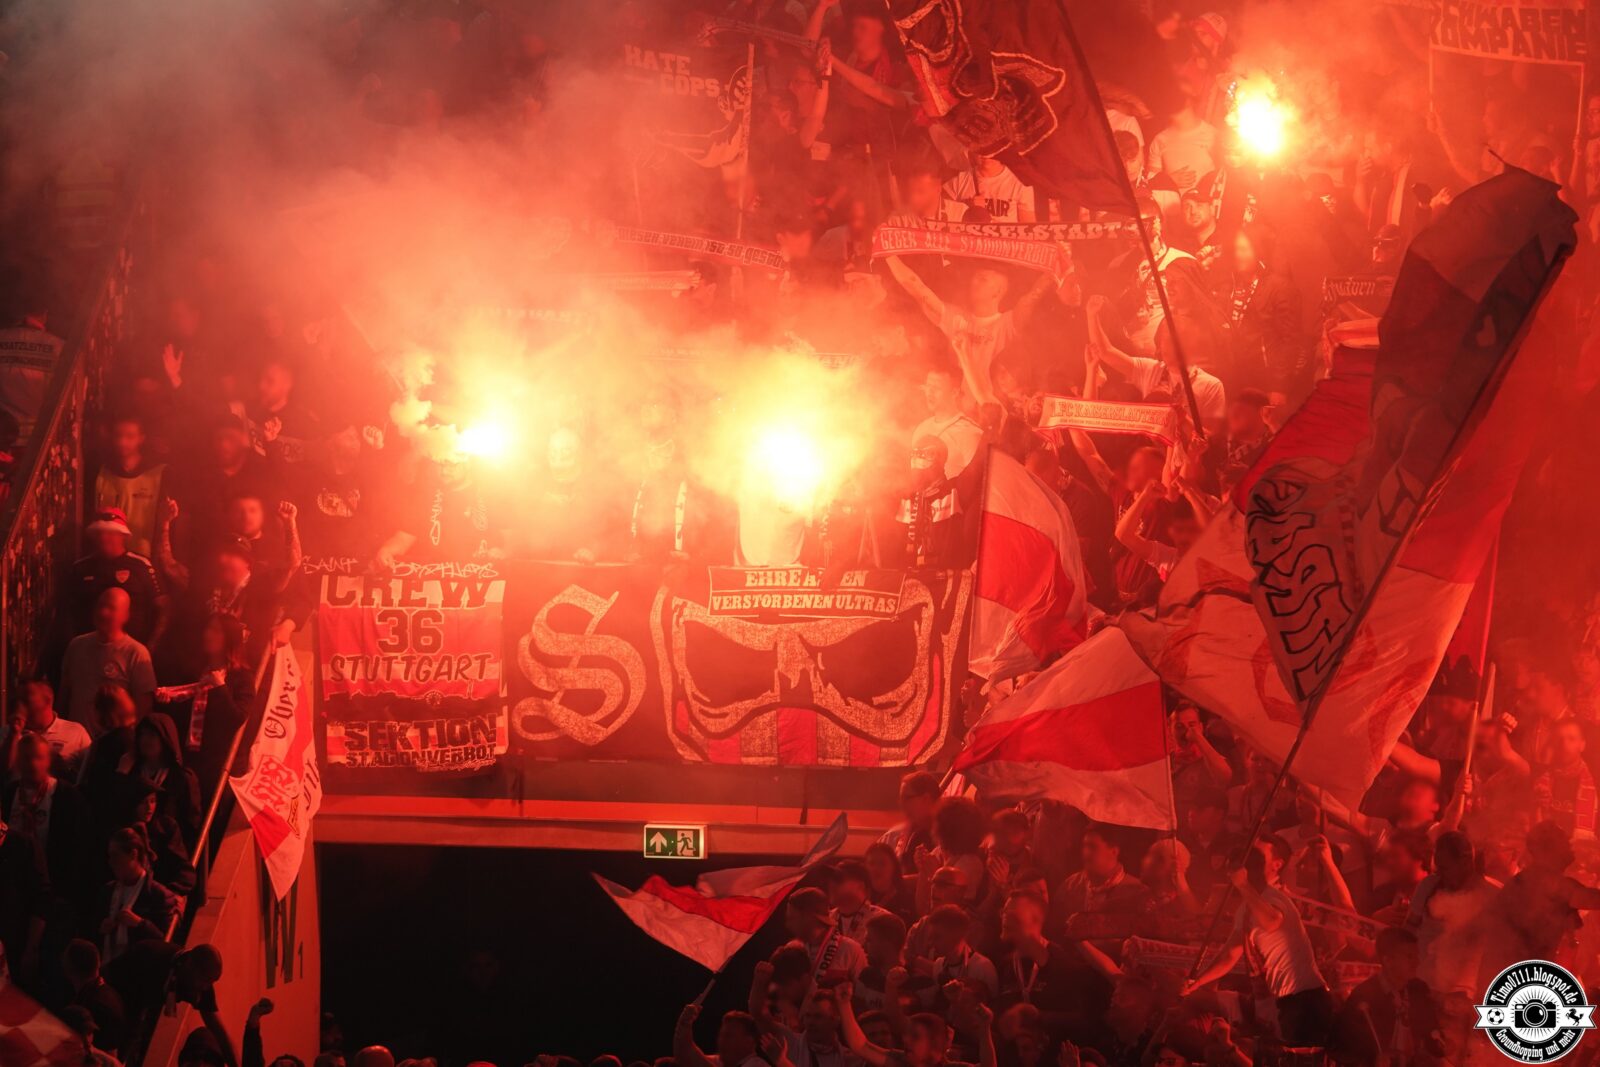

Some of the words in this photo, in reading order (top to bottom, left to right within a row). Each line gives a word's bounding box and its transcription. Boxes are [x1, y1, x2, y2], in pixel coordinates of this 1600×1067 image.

[624, 44, 691, 76] HATE
[660, 73, 720, 98] COPS
[880, 230, 918, 250] GEGEN
[925, 231, 951, 251] ALLE
[303, 555, 358, 574] SAINT
[745, 569, 800, 587] EHRE
[803, 569, 869, 587] AEN
[326, 574, 492, 609] CREW
[711, 594, 834, 611] VERSTORBENEN
[835, 594, 896, 613] ULTRAS
[376, 607, 444, 655] 36
[330, 652, 494, 684] STUTTGART
[344, 713, 498, 751] SEKTION
